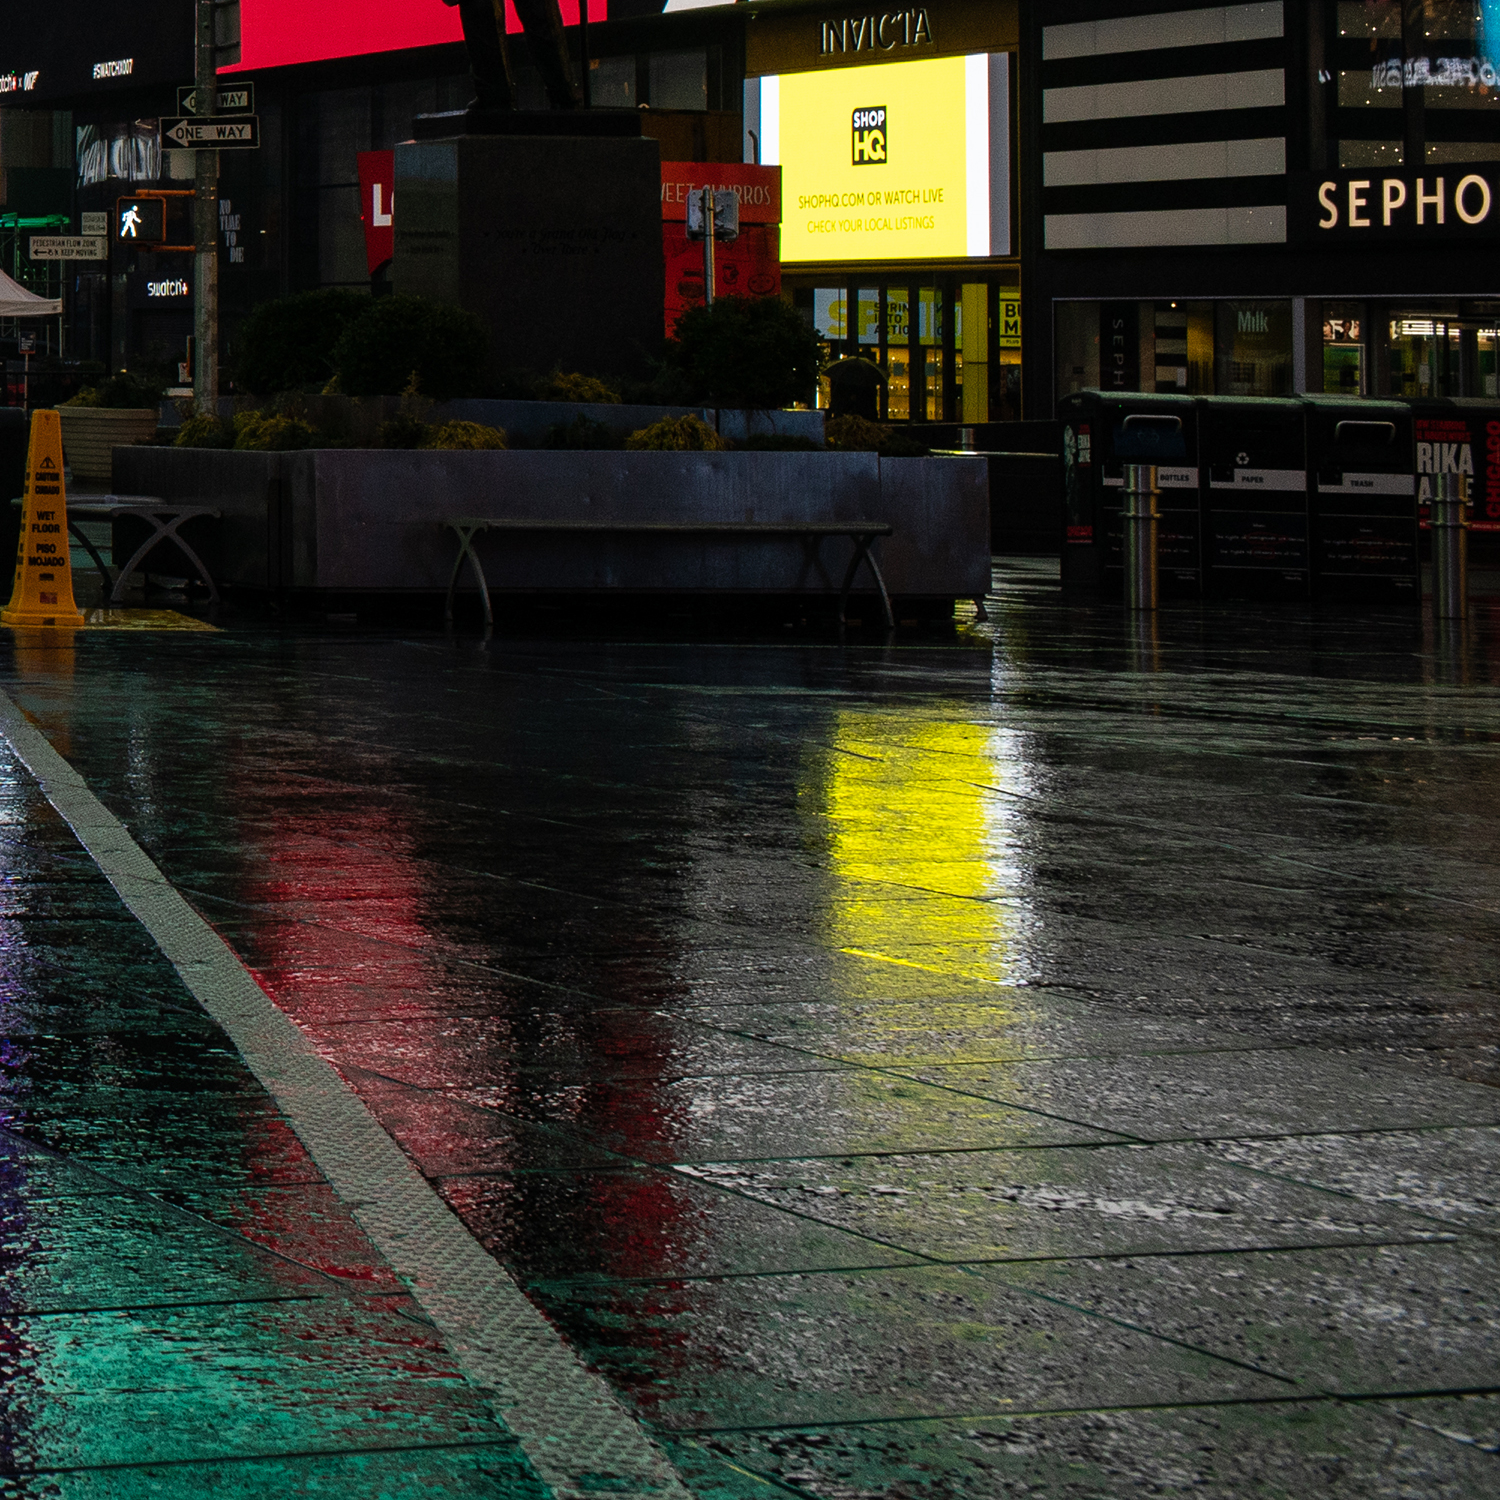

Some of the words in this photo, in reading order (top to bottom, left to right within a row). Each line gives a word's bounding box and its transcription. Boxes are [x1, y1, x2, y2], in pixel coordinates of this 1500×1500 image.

[817, 7, 934, 57] INVICTA
[219, 92, 244, 106] WAY
[852, 109, 886, 129] SHOP
[175, 127, 203, 140] ONE
[216, 126, 246, 140] WAY
[852, 128, 886, 162] HQ
[798, 192, 865, 210] SHOPHQ.COM
[866, 191, 883, 206] OR
[884, 189, 921, 206] WATCH
[922, 188, 945, 204] LIVE
[219, 199, 232, 216] NO
[219, 214, 242, 231] TIME
[807, 219, 837, 234] CHECK
[838, 218, 863, 232] YOUR
[864, 217, 893, 232] LOCAL
[894, 215, 935, 231] LISTINGS
[31, 238, 66, 248] PEDESTRIAN
[66, 238, 81, 247] FLOW
[81, 238, 97, 247] ZONE
[224, 231, 237, 247] TO
[60, 248, 78, 258] KEEP
[78, 248, 98, 258] MOVING
[229, 247, 245, 263] DIE
[147, 278, 182, 297] swatch
[1237, 310, 1269, 334] Milk
[35, 472, 60, 482] CAUTION
[1160, 473, 1190, 484] BOTTLES
[1241, 475, 1265, 485] PAPER
[1350, 479, 1374, 489] TRASH
[34, 486, 60, 496] CUIDADO
[36, 511, 56, 521] WET
[31, 523, 60, 534] FLOOR
[36, 544, 57, 554] PISO
[28, 557, 65, 567] MOJADO
